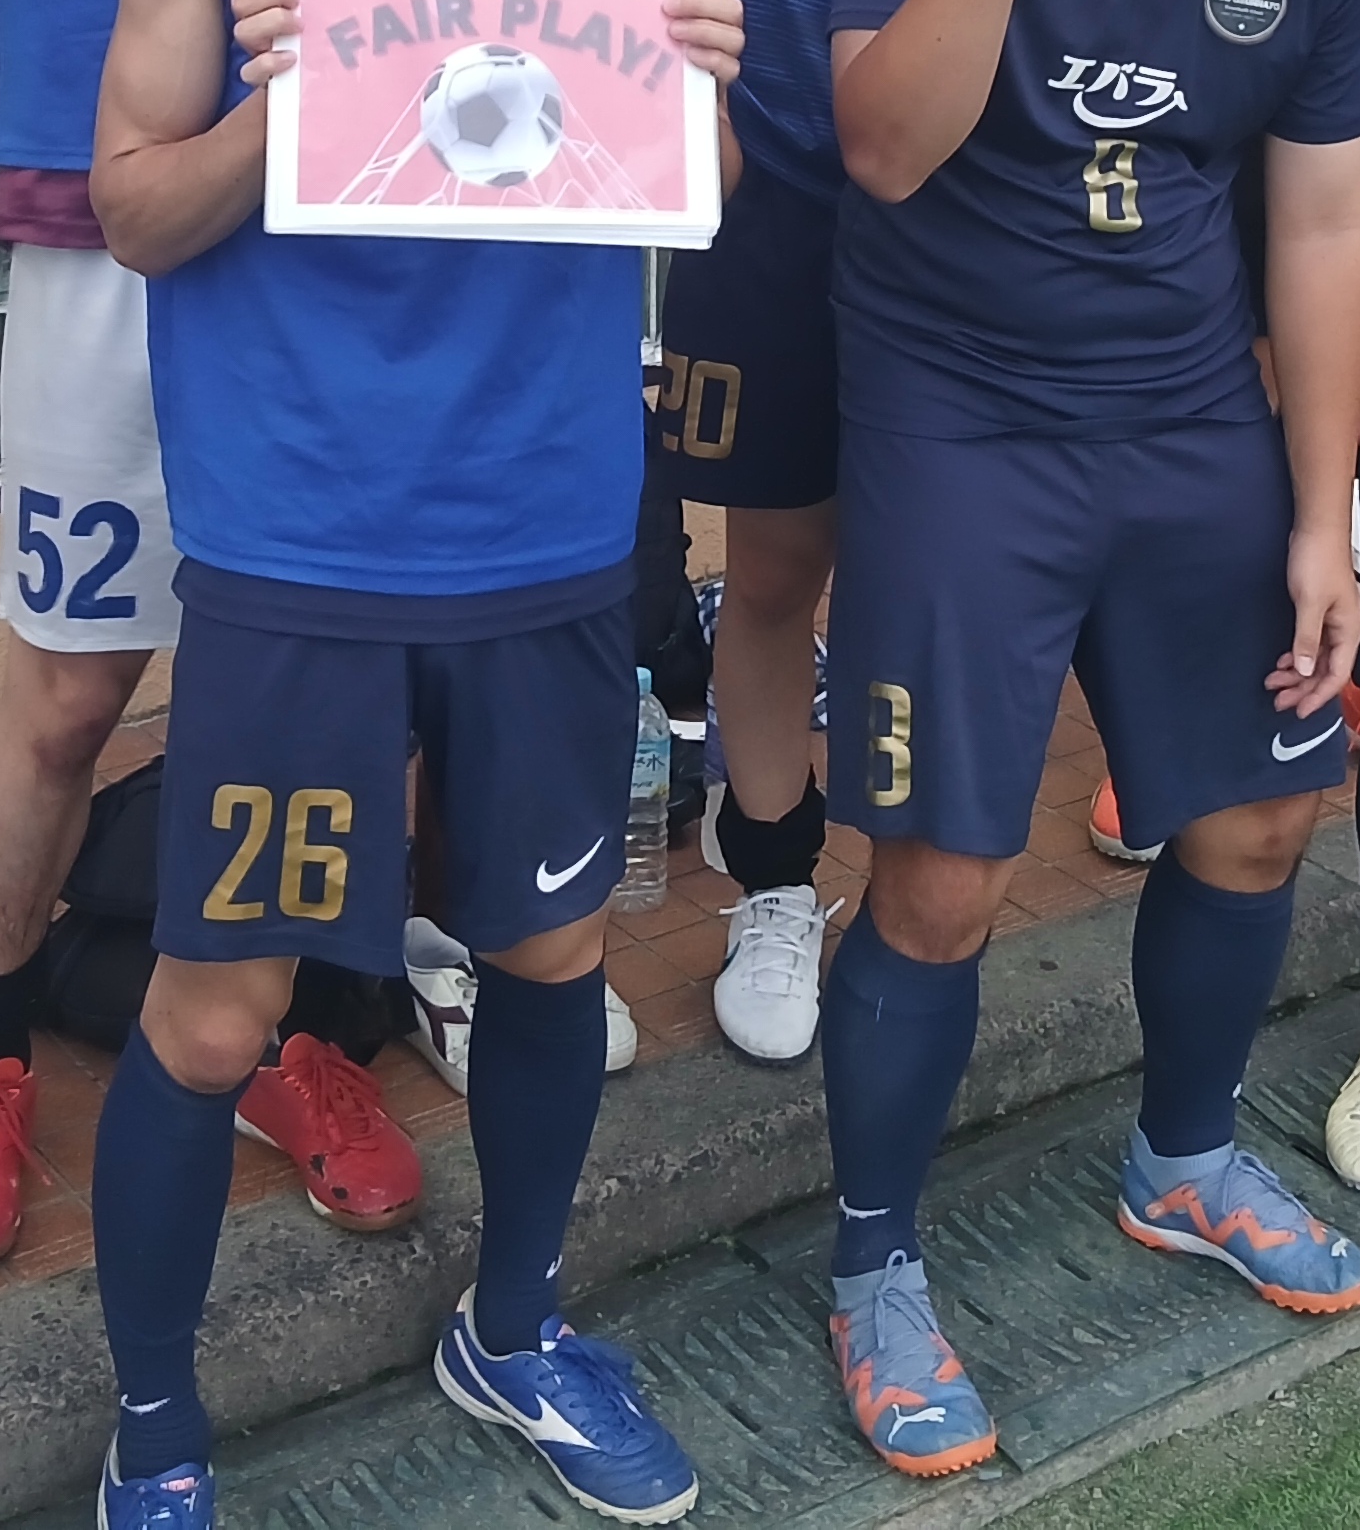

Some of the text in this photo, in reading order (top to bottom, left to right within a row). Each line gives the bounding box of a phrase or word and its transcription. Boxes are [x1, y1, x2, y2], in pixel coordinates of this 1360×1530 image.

[1047, 54, 1178, 107] エバラ
[17, 485, 141, 619] 52
[202, 783, 353, 921] 26
